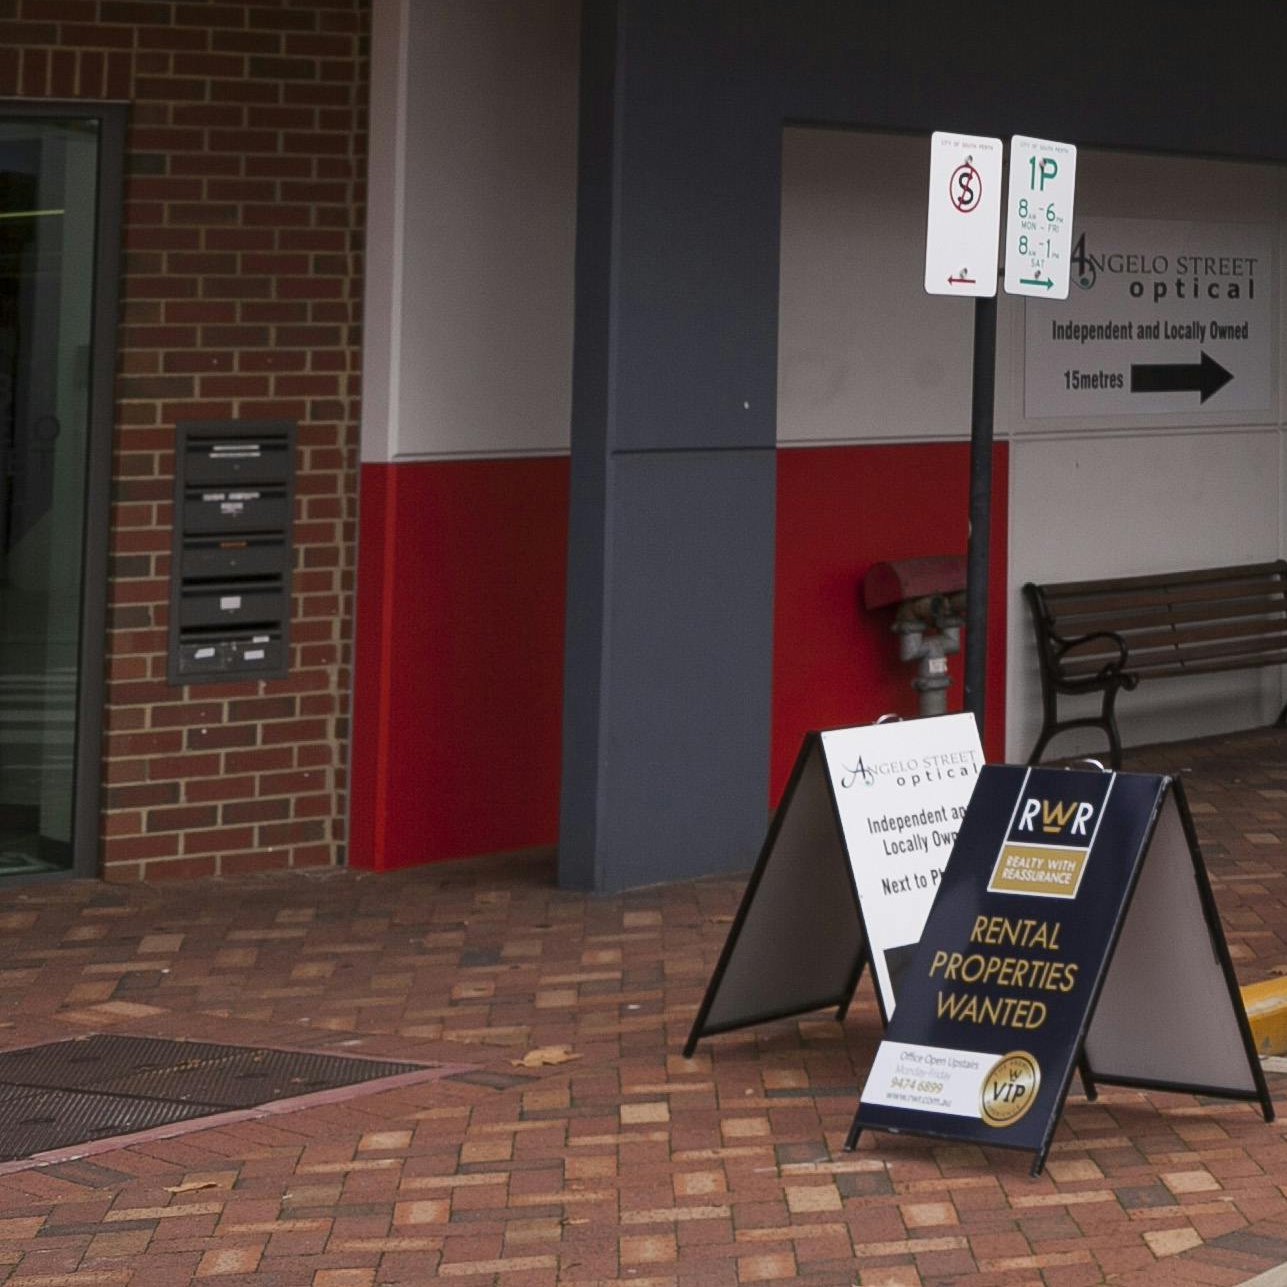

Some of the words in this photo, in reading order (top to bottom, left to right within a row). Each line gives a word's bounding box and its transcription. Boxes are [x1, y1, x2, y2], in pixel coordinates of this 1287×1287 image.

[1029, 155, 1058, 191] 1P
[1021, 220, 1037, 231] MON
[1047, 223, 1060, 233] FRI
[1030, 258, 1045, 268] SAT
[1176, 254, 1259, 277] STREET
[1129, 277, 1255, 303] optical
[1052, 320, 1133, 344] Independent
[1136, 320, 1160, 340] and
[1164, 320, 1206, 343] Locally
[1210, 320, 1249, 340] Owned
[1064, 370, 1124, 390] 15metres
[922, 750, 977, 770] STREET
[897, 762, 979, 787] optical
[867, 806, 948, 834] Independent
[951, 805, 968, 820] an
[1018, 798, 1094, 835] RWR
[883, 834, 929, 857] Locally
[932, 829, 960, 848] Own
[1006, 855, 1045, 869] REALTY
[1047, 859, 1077, 872] WITH
[881, 874, 911, 896] Next
[914, 872, 928, 889] to
[1002, 867, 1073, 885] REASSURANCE
[969, 915, 1061, 950] RENTAL
[928, 950, 1079, 993] PROPERTIES
[937, 990, 1047, 1029] WANTED
[900, 1051, 924, 1063] Office
[924, 1054, 946, 1066] Open
[889, 1076, 916, 1089] 9474
[917, 1080, 944, 1094] 6899
[993, 1081, 1026, 1104] VIP
